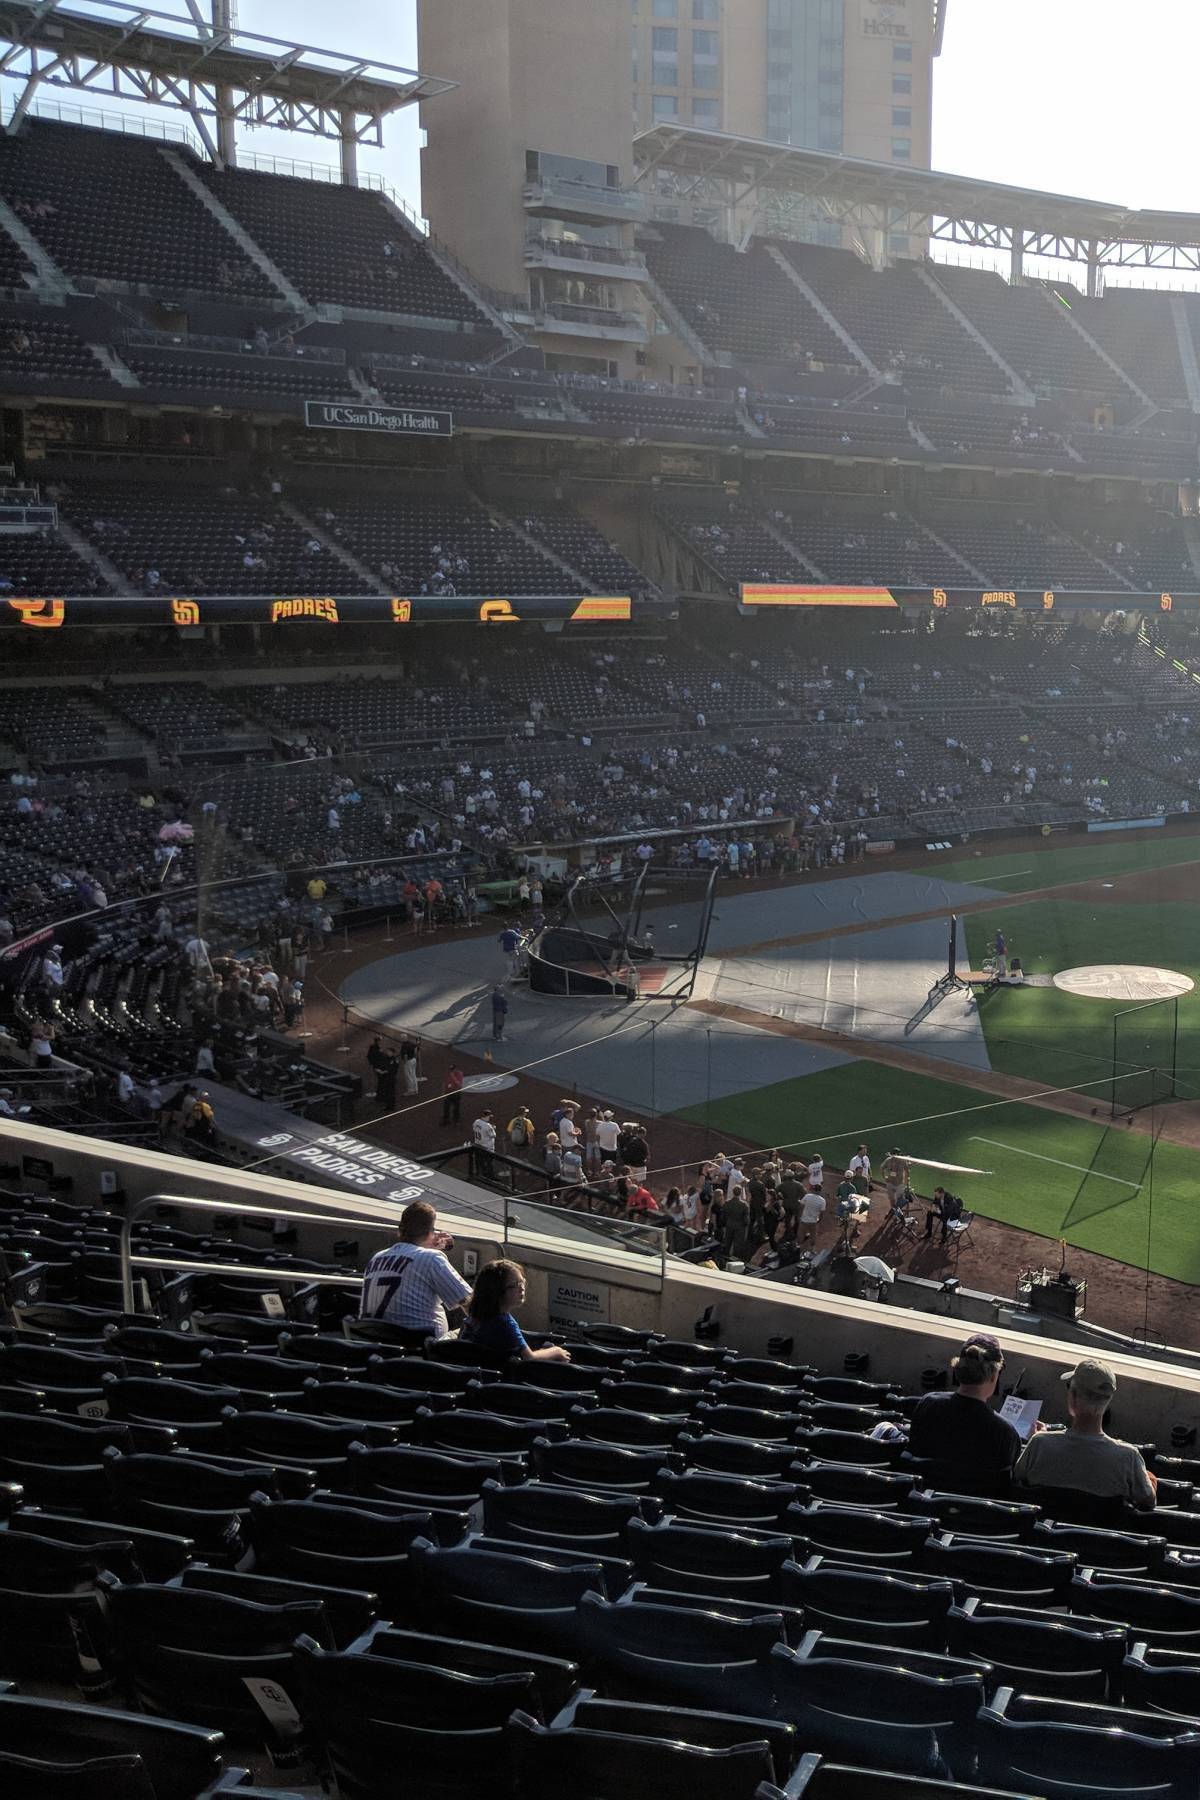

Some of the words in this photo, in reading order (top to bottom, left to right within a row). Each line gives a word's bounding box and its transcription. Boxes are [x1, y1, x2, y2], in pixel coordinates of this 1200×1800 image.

[344, 408, 368, 425] San
[368, 410, 401, 431] Diego
[402, 413, 439, 430] Health
[271, 597, 339, 623] PADRES
[981, 591, 1016, 607] PADRES
[292, 1148, 386, 1185] PADRES
[318, 1133, 366, 1154] SAN
[358, 1145, 435, 1180] DIEGO
[361, 1276, 402, 1319] 17
[558, 1286, 599, 1302] CAUTION
